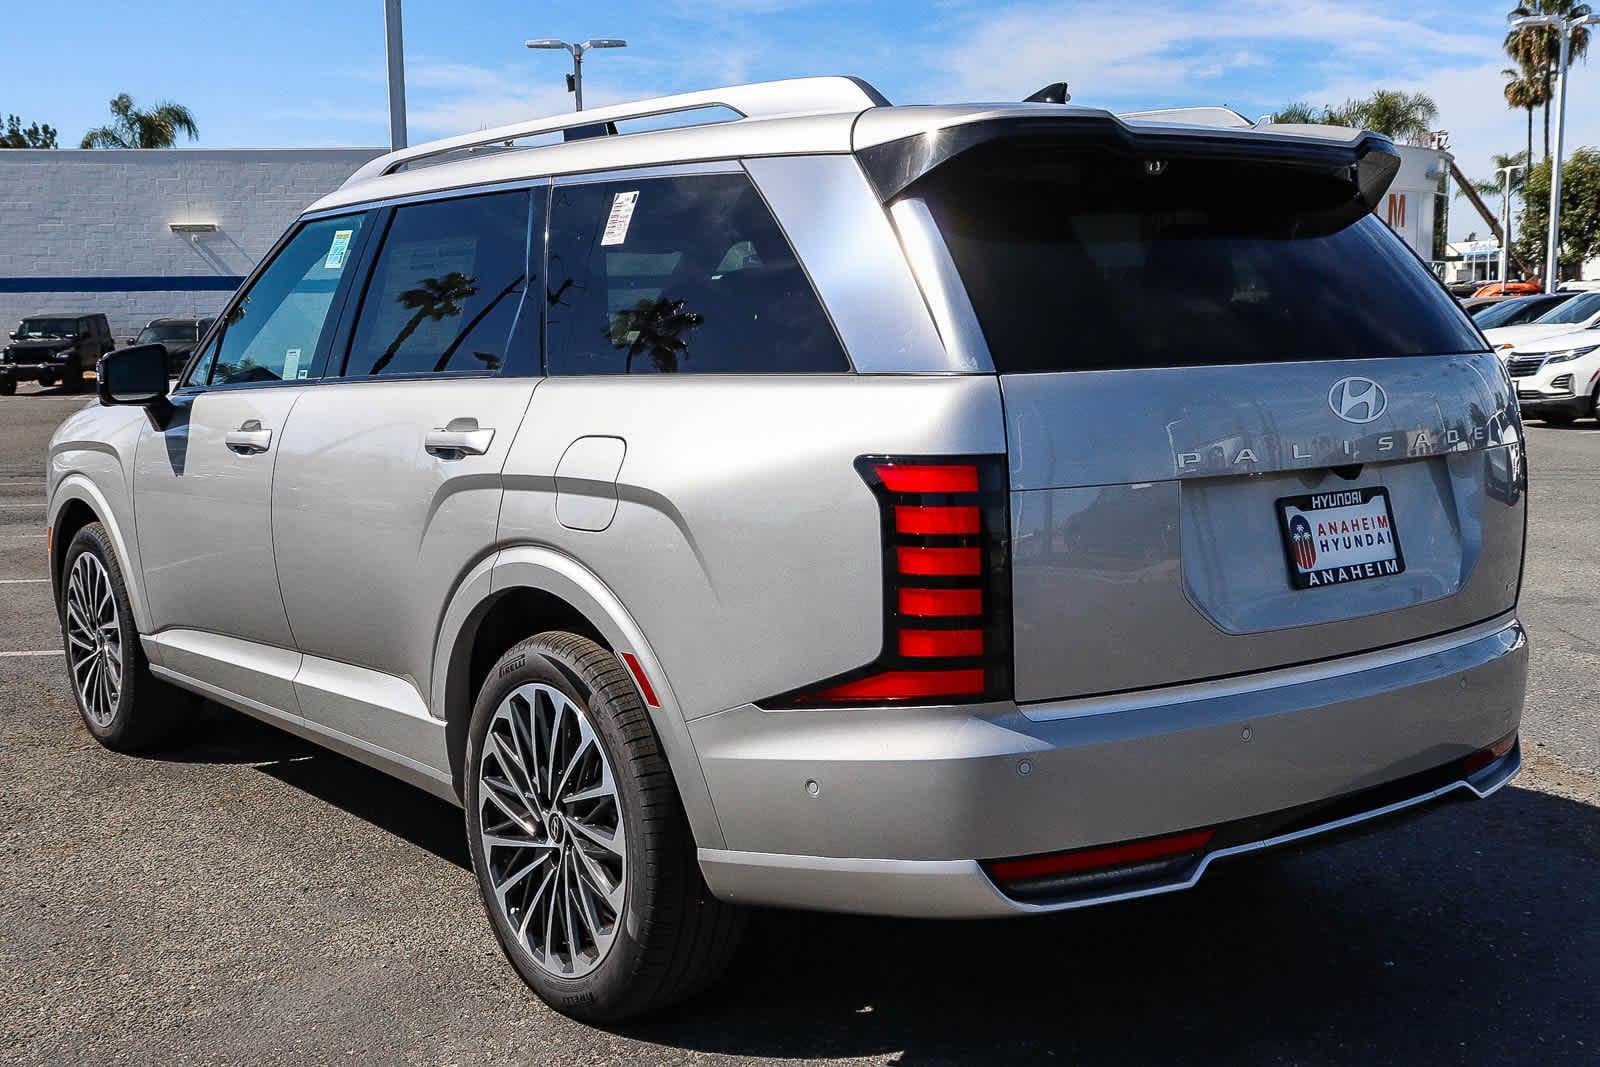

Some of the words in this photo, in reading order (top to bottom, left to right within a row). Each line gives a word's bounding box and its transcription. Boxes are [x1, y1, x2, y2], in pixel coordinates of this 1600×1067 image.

[1176, 426, 1484, 468] PALISADE
[1311, 491, 1362, 509] HYUNDAI
[1317, 515, 1388, 536] ANAHEIM
[1320, 531, 1391, 553] HYUNDAI
[1309, 559, 1399, 586] ANAHEIM
[499, 654, 526, 679] PIRELLI
